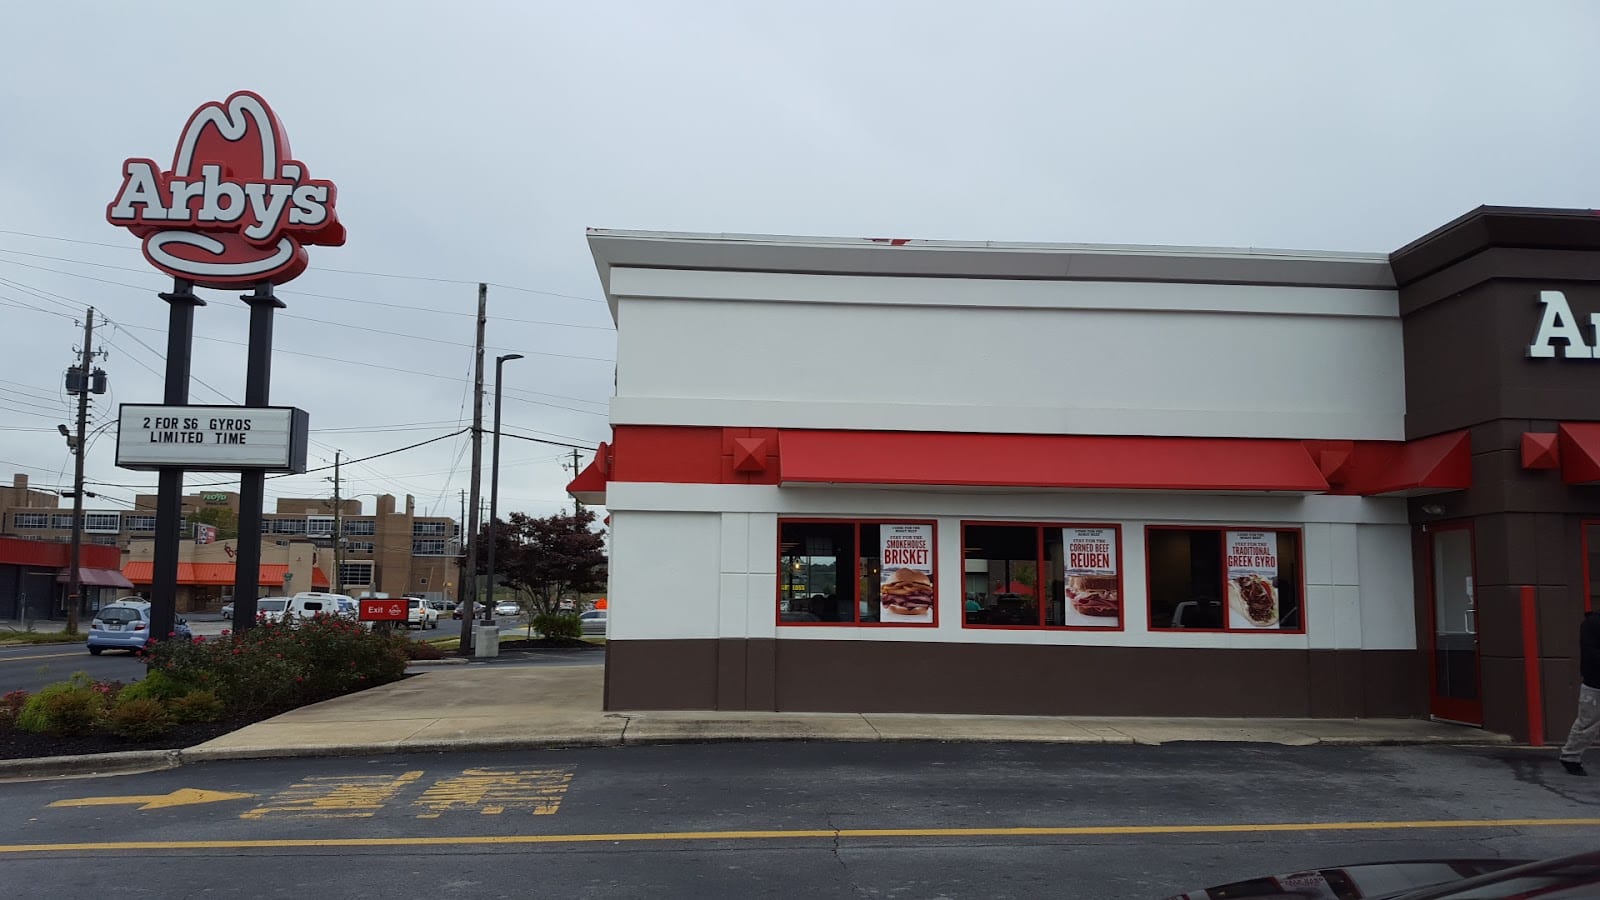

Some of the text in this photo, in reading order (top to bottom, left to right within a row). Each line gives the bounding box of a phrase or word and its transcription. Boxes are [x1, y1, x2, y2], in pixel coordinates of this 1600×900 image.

[111, 161, 328, 239] Arby's
[143, 417, 151, 429] 2
[155, 417, 179, 430] FOR
[209, 418, 252, 431] GYROS
[150, 431, 247, 445] LIMITED TIME
[886, 540, 926, 549] SMOKEHOUSE
[1069, 543, 1110, 553] CORNED BEEF
[1232, 546, 1271, 555] TRADITIONAL
[884, 549, 929, 565] BRISKET
[1070, 553, 1110, 568] REUBEN
[1228, 555, 1276, 567] GREEK GYRO
[368, 606, 384, 614] Exit
